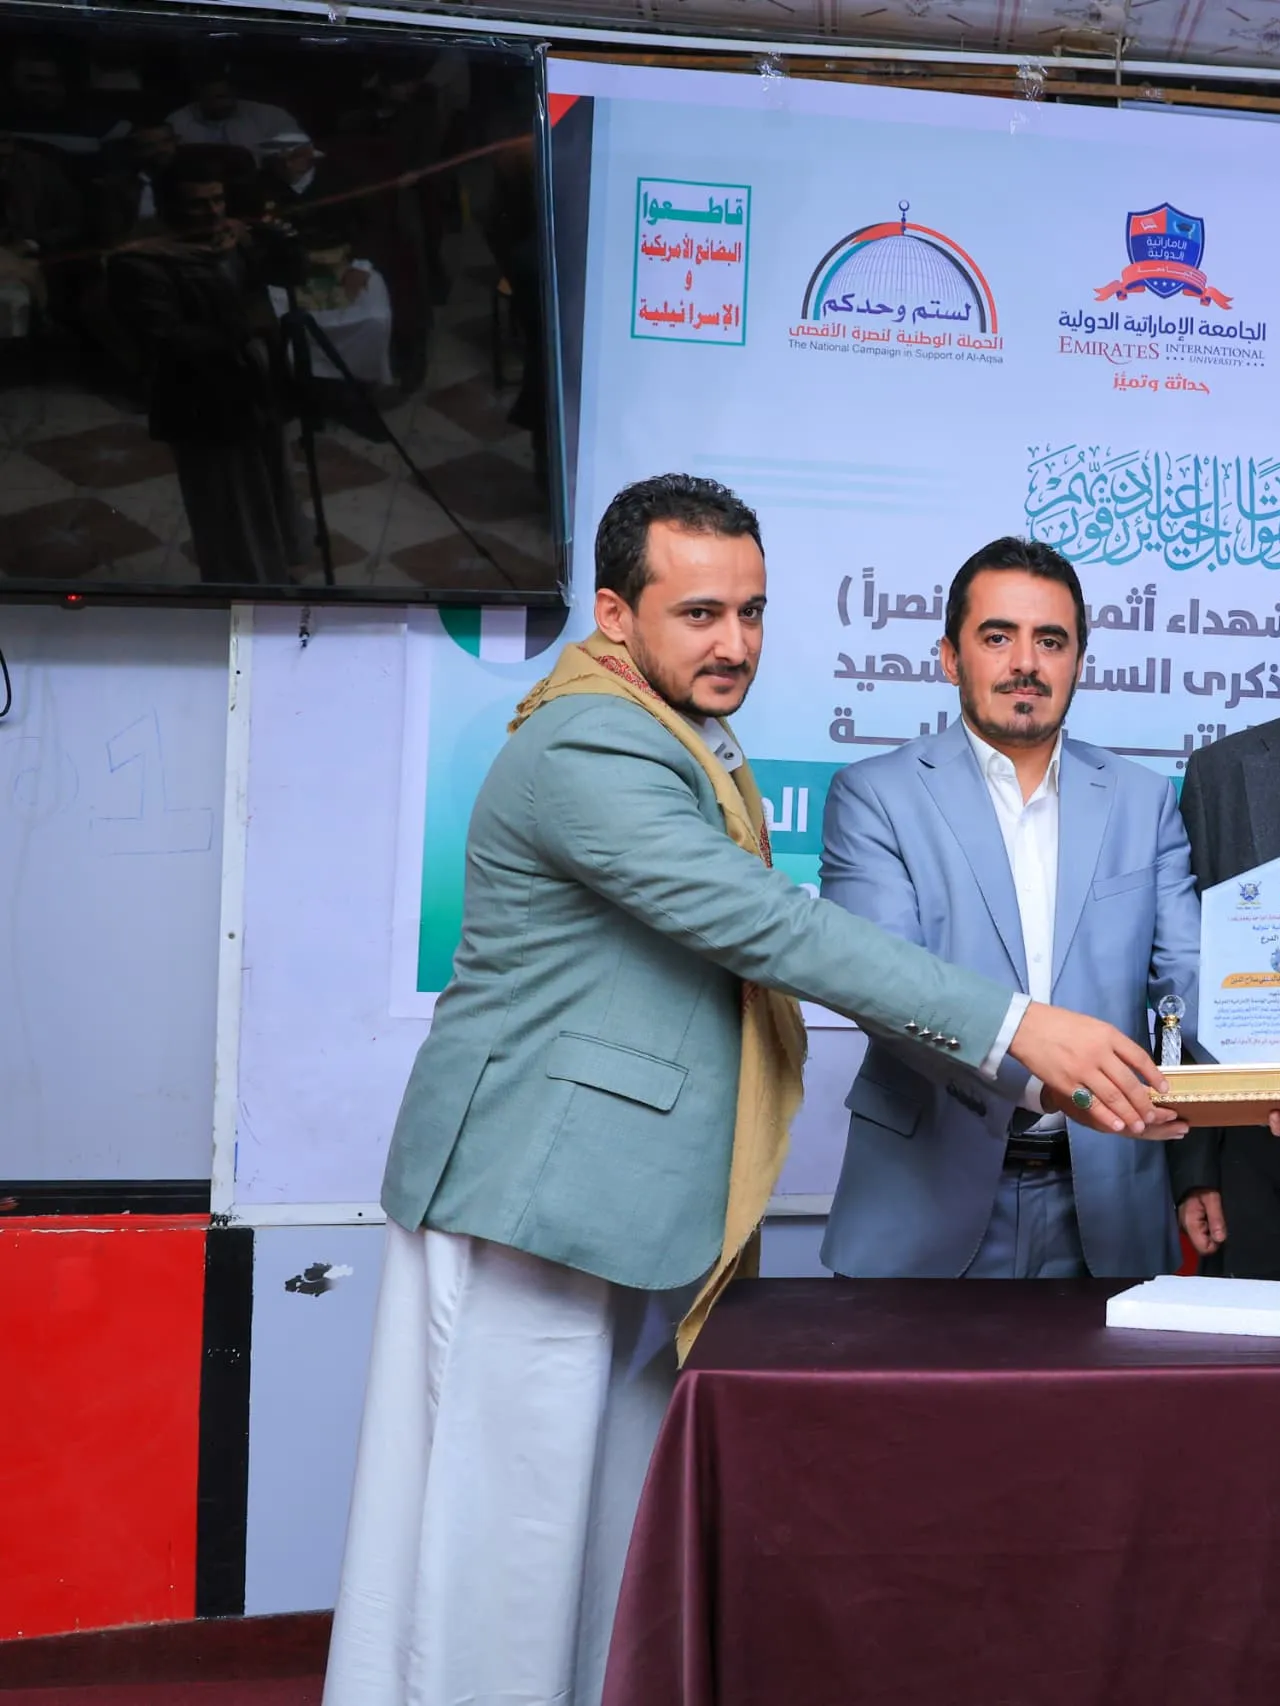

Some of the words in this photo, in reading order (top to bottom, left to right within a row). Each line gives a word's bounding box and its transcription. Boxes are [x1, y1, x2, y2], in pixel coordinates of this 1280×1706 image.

[695, 237, 742, 267] البضائع
[685, 270, 693, 291] و
[912, 300, 972, 325] لستم
[1058, 309, 1119, 334] الدولية
[789, 322, 846, 338] الأقصى
[851, 325, 891, 343] لنصرة
[896, 329, 952, 348] الوطنية
[1123, 314, 1195, 342] الإماراتية
[1198, 318, 1266, 345] الجامعة
[788, 339, 808, 349] The
[810, 341, 850, 352] National
[852, 344, 901, 358] Campaign
[903, 348, 913, 357] in
[915, 349, 952, 361] Support
[955, 351, 965, 361] of
[966, 352, 1004, 364] Al-Aqsa
[957, 333, 1004, 350] الحملة
[1058, 335, 1160, 366] EMIRATES
[1165, 343, 1265, 360] INTERNATIONAL
[1189, 356, 1246, 367] UNIVERSITY
[1165, 373, 1210, 394] حداثة
[1085, 583, 1157, 634] أثمر
[834, 639, 951, 692] شهيد
[1077, 655, 1172, 694] السن
